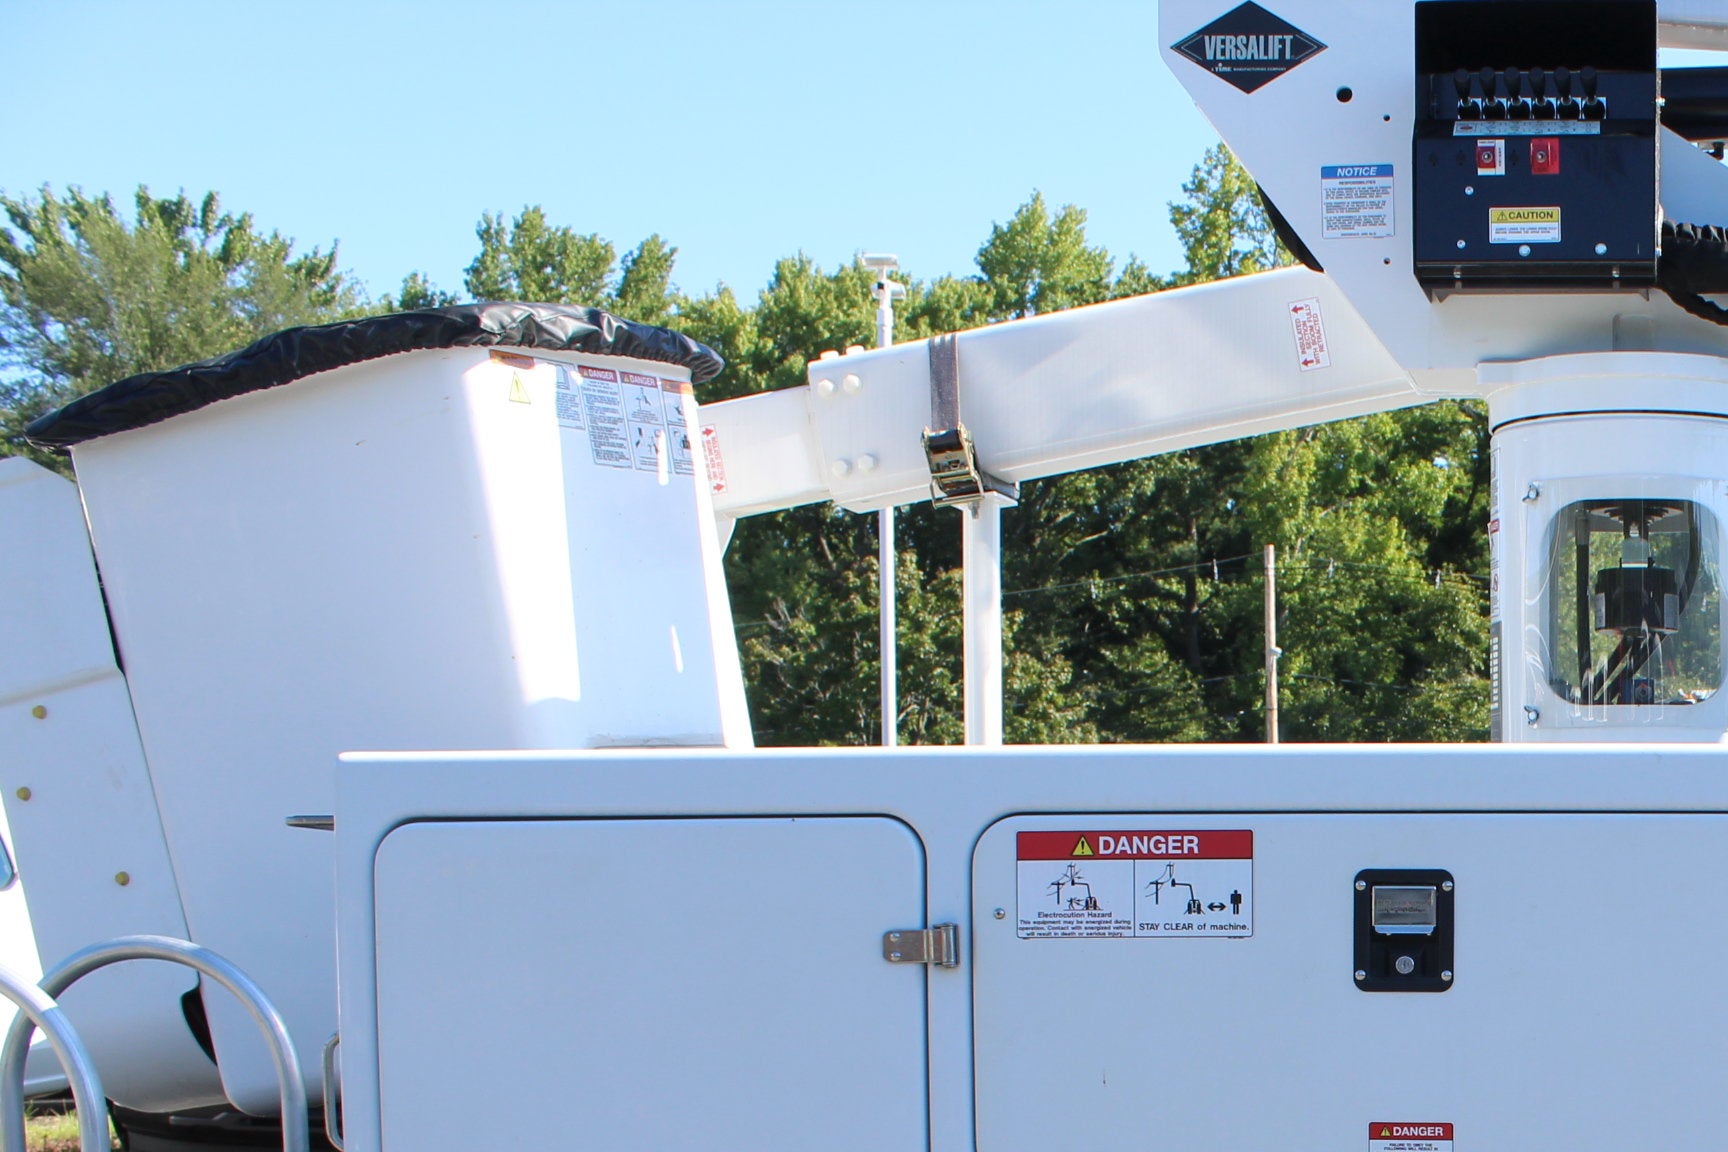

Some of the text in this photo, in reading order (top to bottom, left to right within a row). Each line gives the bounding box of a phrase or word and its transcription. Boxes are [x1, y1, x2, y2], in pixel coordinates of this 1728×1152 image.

[1204, 34, 1293, 60] VERSALIFT
[1337, 166, 1377, 176] NOTICE
[1509, 211, 1553, 219] CAUTION
[1295, 318, 1307, 354] INSULATED
[1309, 326, 1317, 346] BOOM
[588, 369, 614, 380] DANGER
[629, 375, 655, 386] DANGER
[1099, 836, 1199, 854] DANGER
[1139, 923, 1249, 931] STAY CLEAR of machine.
[1393, 1127, 1443, 1136] DANGER
